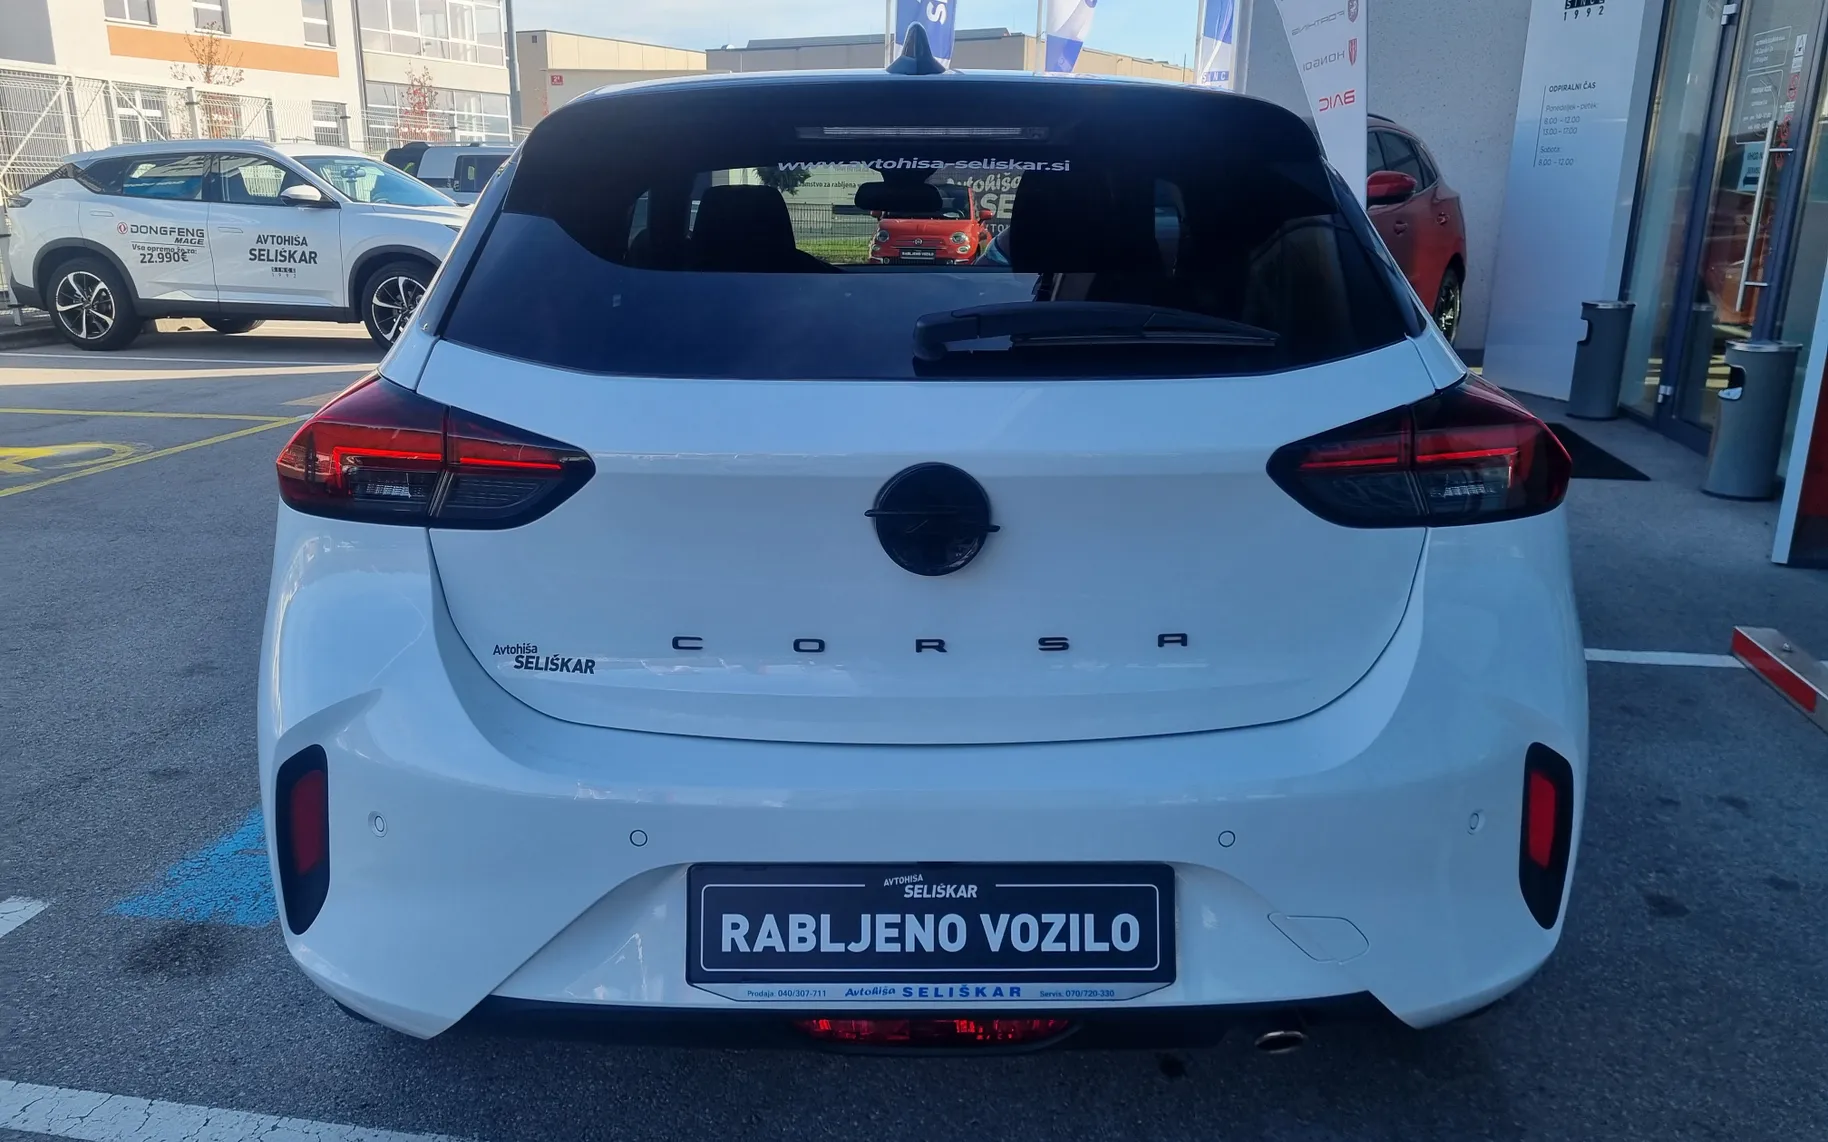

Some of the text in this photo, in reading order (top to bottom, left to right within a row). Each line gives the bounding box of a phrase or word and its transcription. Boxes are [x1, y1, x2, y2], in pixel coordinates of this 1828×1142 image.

[1549, 80, 1596, 93] ODPIRALNI ČAS
[831, 180, 857, 190] rabljena
[130, 224, 205, 238] DONGFENG
[132, 243, 146, 251] Vsa
[174, 237, 205, 246] MAGE
[255, 234, 309, 247] AVTOHIŠA
[140, 251, 189, 264] 22.990€
[249, 247, 318, 265] SELIŠKAR
[492, 642, 538, 656] Avtohiša
[672, 632, 1188, 653] CORSA
[513, 653, 596, 675] SELIŠKAR
[883, 873, 924, 887] AVTOHIŠA
[903, 882, 978, 899] SELIŠKAR
[721, 912, 1140, 953] RABLJENO VOZILO
[777, 989, 827, 998] 040/307-711
[844, 983, 1021, 998] Avtohiša SELIŠKAR
[1065, 989, 1115, 998] 070/720-330
